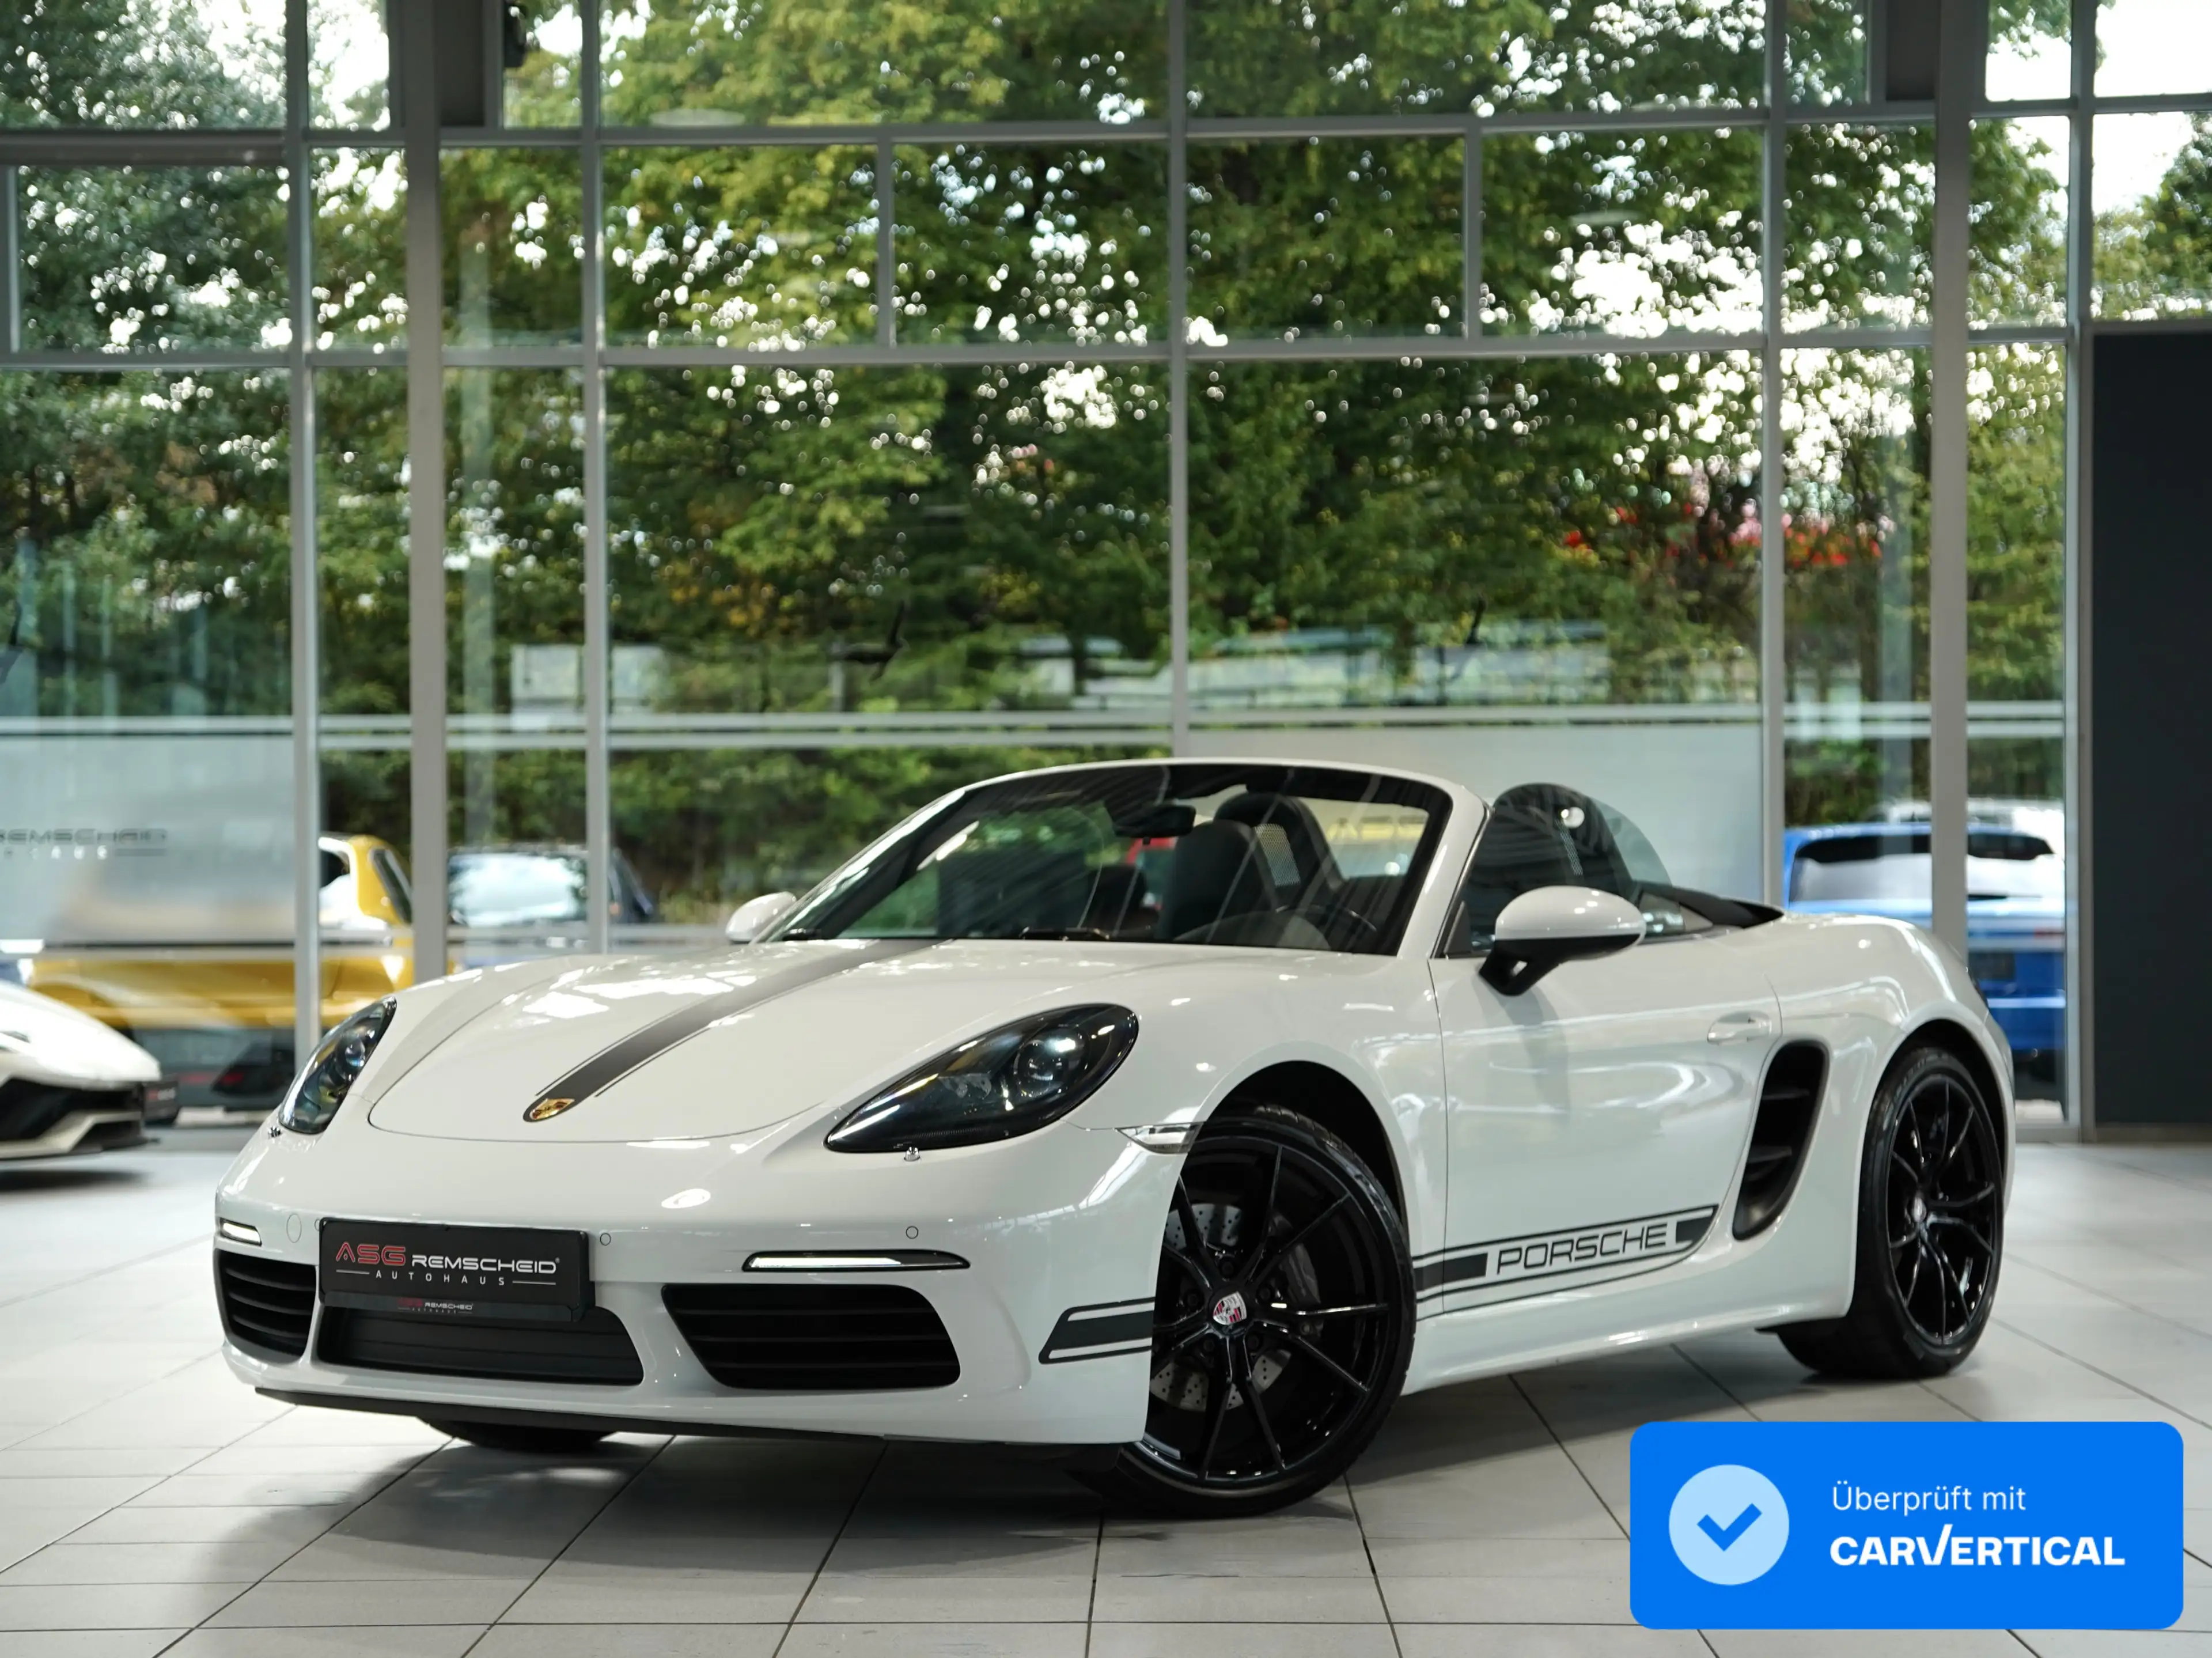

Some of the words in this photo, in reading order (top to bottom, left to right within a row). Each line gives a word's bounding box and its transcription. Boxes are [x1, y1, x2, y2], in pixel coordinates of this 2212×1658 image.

[335, 1241, 406, 1267] ASG
[1497, 1222, 1668, 1275] PORSCHE
[376, 1269, 505, 1286] AUTOHAUS
